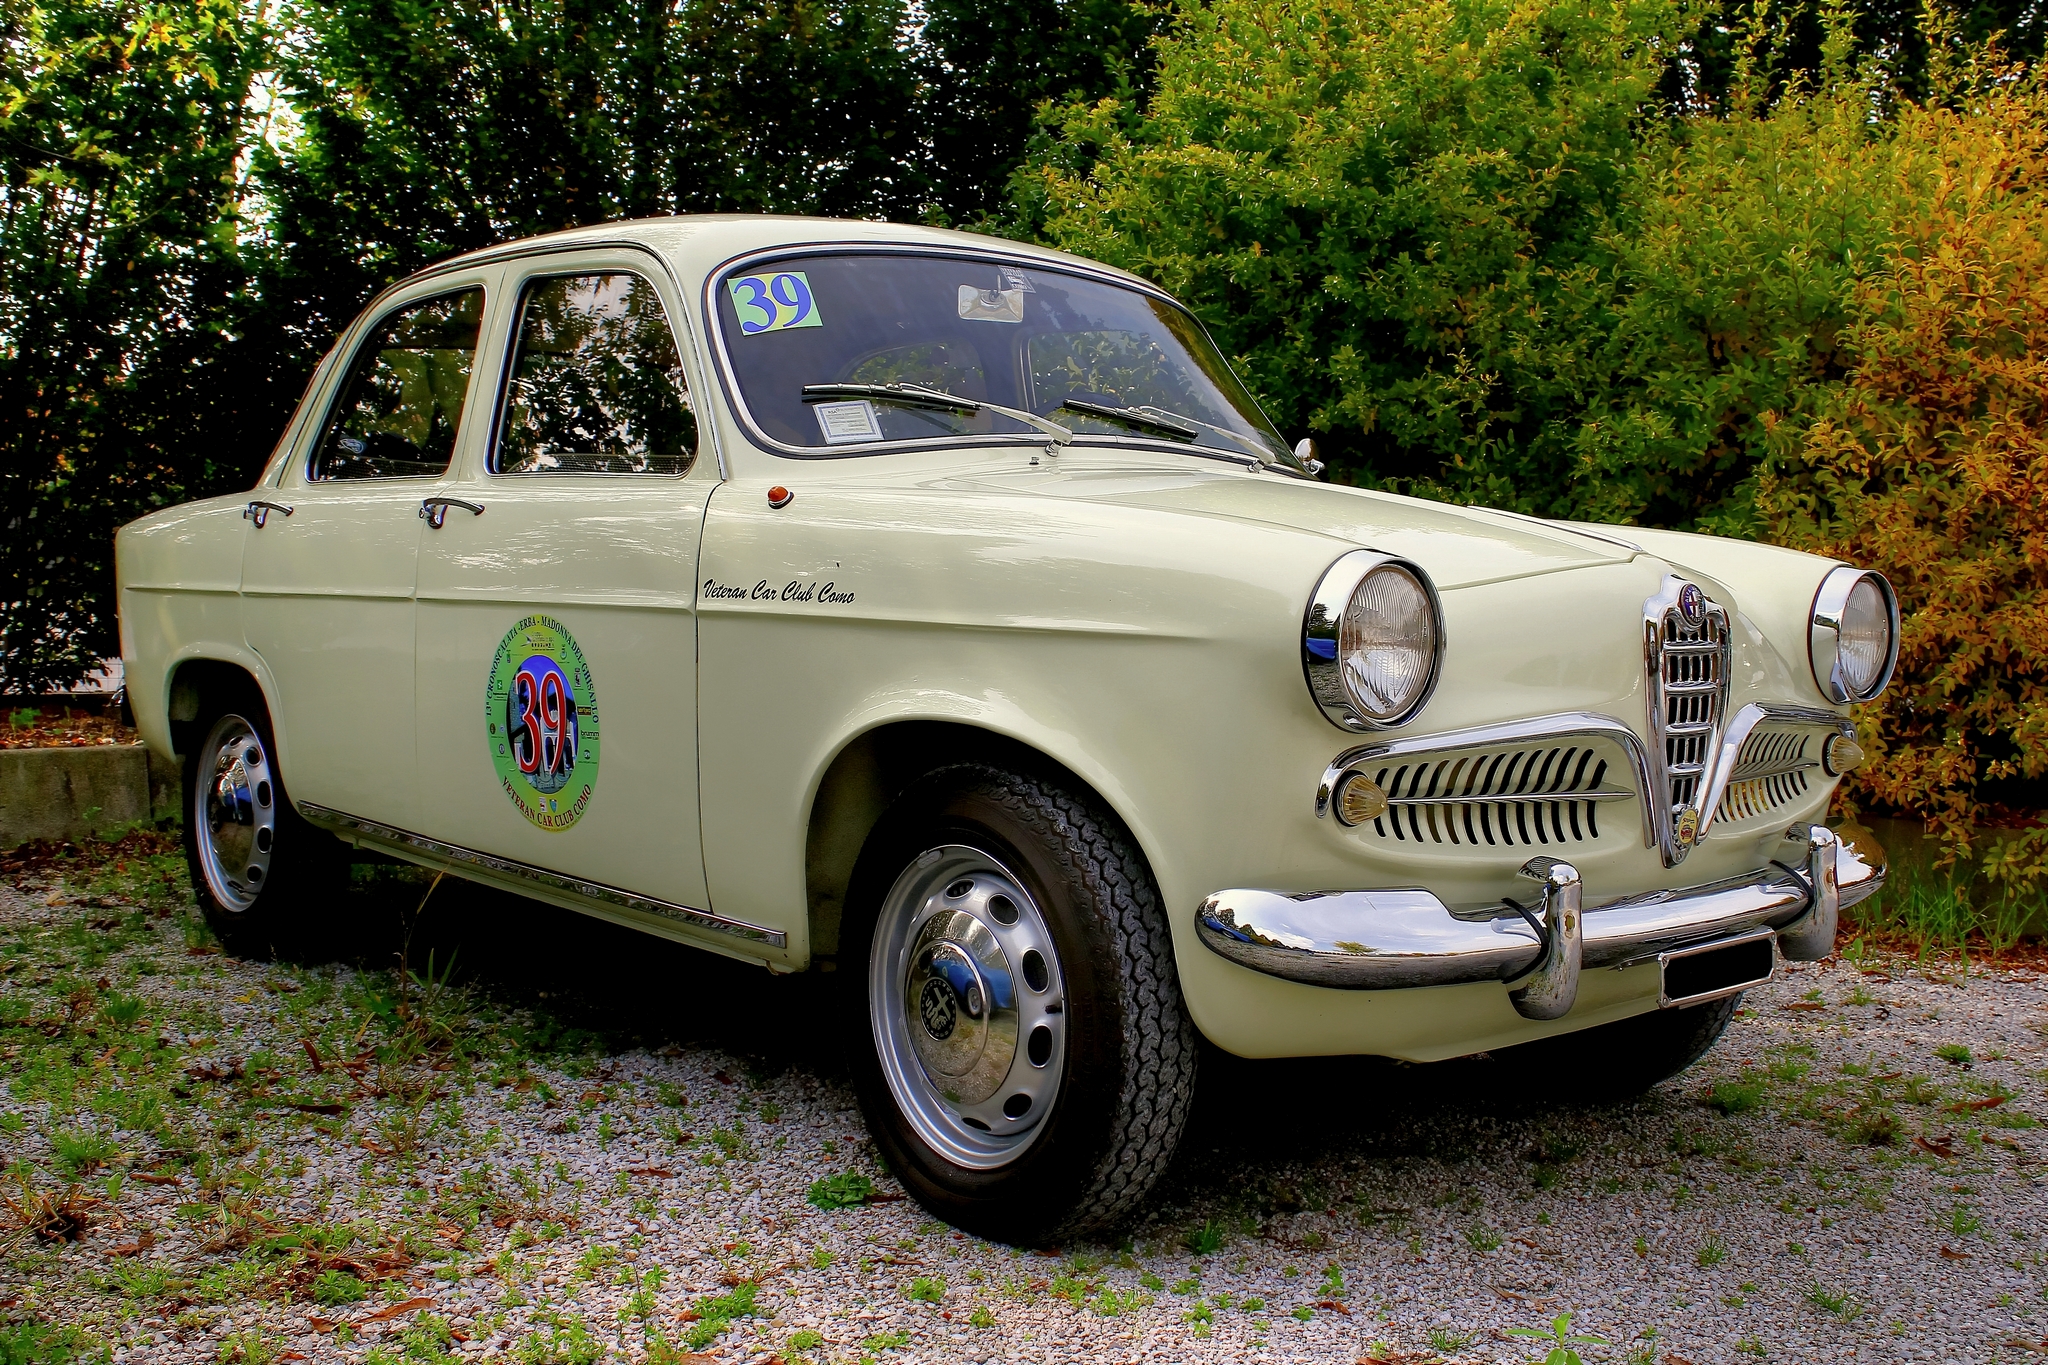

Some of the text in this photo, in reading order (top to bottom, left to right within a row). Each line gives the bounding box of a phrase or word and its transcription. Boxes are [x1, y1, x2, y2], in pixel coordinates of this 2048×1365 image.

[733, 274, 811, 332] 39
[703, 579, 855, 603] Veteran Car Club Como
[486, 627, 518, 699] CRONOSCALATA
[541, 616, 572, 645] MADONNA
[571, 641, 583, 663] DEL
[581, 663, 599, 723] GHISALLO
[516, 670, 567, 774] 39
[502, 776, 592, 827] VETERAN CAR CLUB COMO
